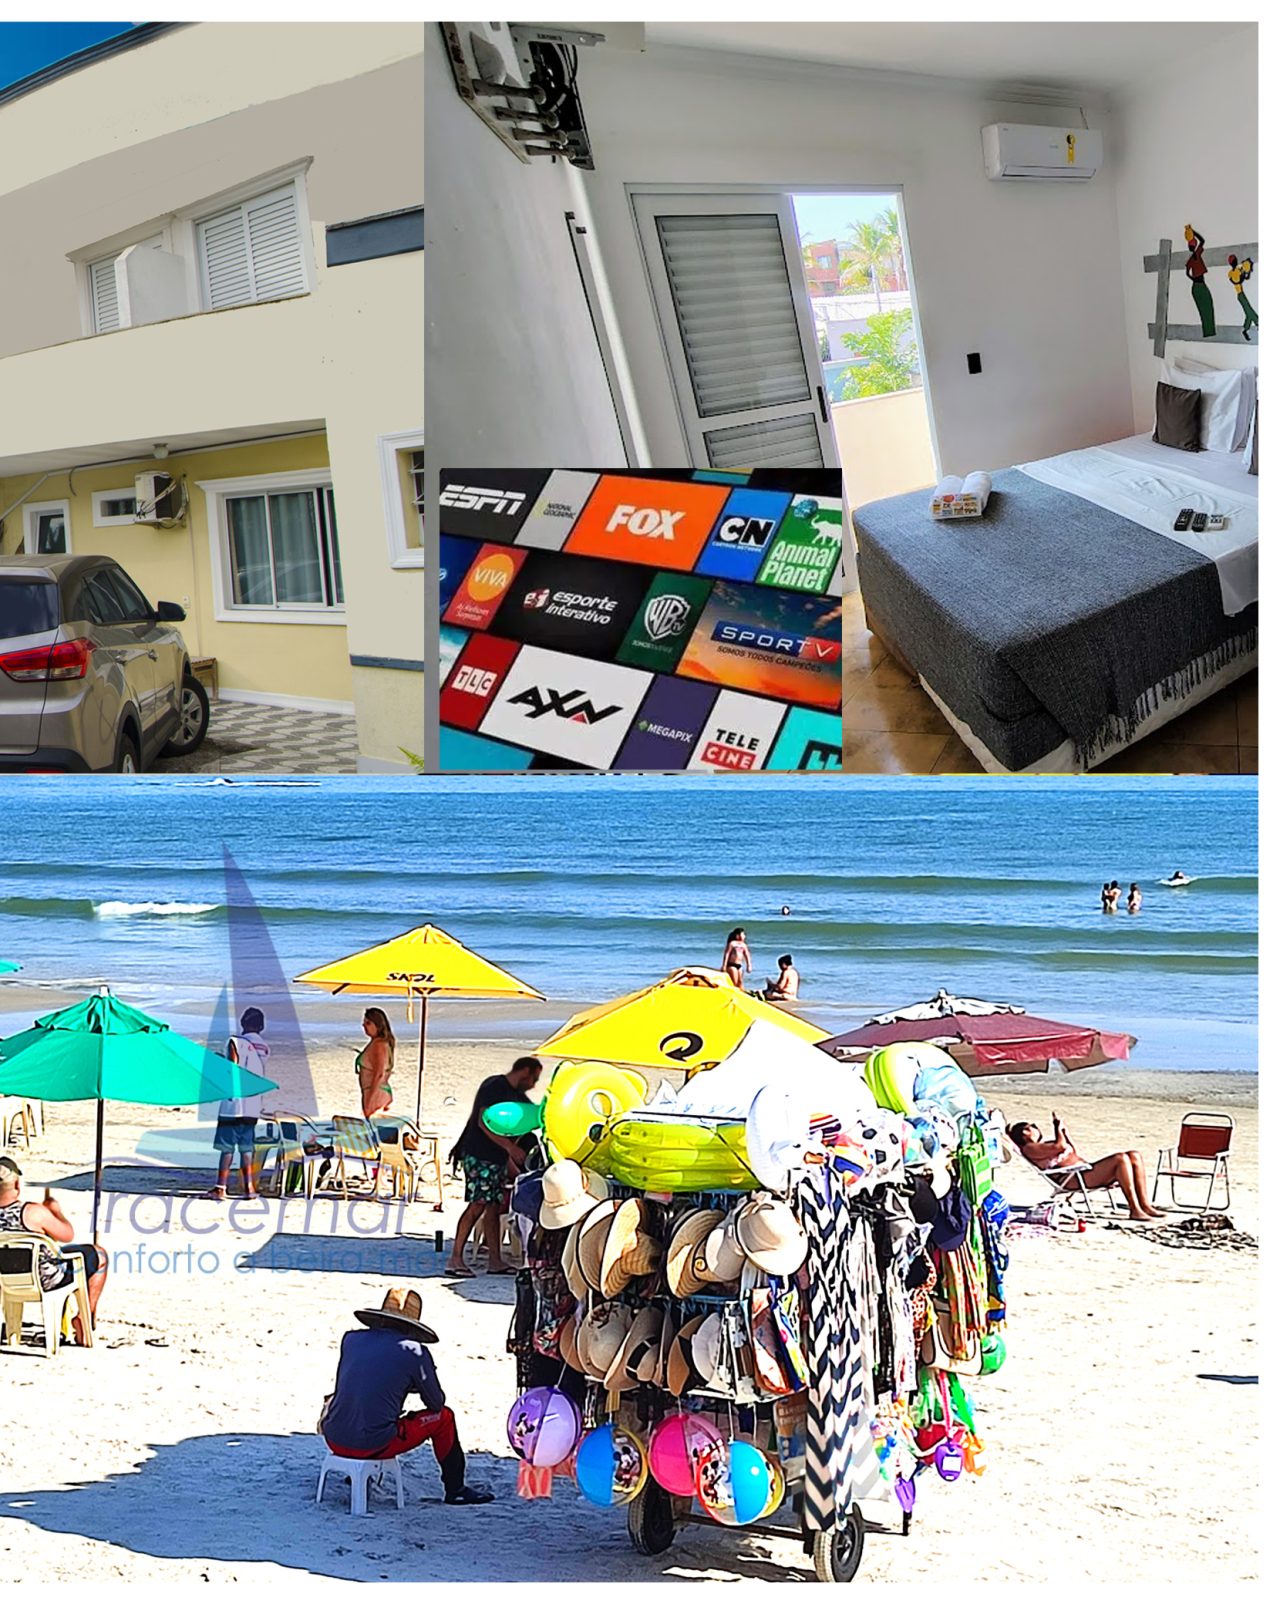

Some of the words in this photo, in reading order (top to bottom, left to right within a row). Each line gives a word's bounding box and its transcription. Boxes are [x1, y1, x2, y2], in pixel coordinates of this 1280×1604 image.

[440, 484, 526, 515] ESPN
[605, 504, 686, 541] FOX
[720, 517, 775, 547] CN
[770, 541, 836, 568] Animal
[474, 567, 507, 588] VIVA
[760, 561, 828, 590] Planet
[553, 591, 618, 611] esporte
[545, 603, 611, 624] interativo
[717, 646, 745, 657] SOMOS
[747, 652, 774, 663] TODOS
[457, 671, 493, 691] TLC
[507, 686, 623, 724] AXN
[648, 723, 693, 743] MEGAPIX
[716, 729, 759, 751] TELE
[706, 747, 752, 769] CINE
